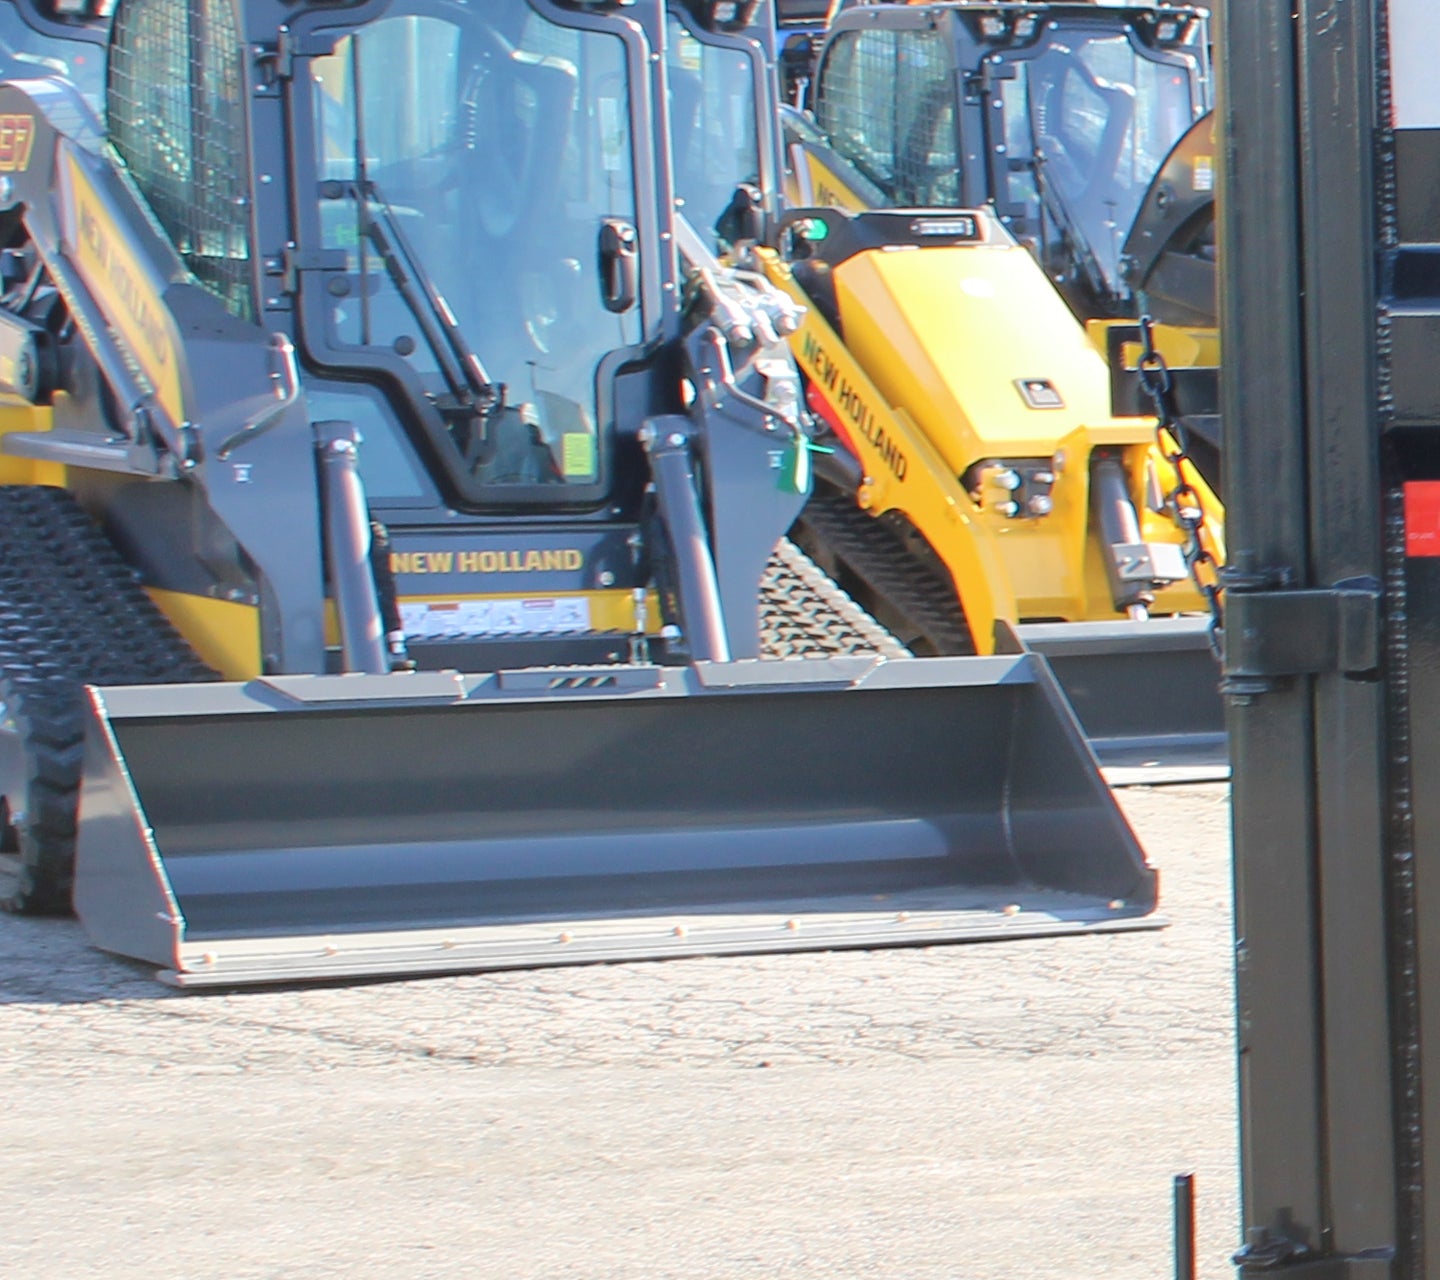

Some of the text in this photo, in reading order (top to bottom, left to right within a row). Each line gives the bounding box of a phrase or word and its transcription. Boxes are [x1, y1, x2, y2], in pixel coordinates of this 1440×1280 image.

[803, 331, 908, 483] NEW HOLLAND
[389, 549, 584, 573] NEW HOLLAND
